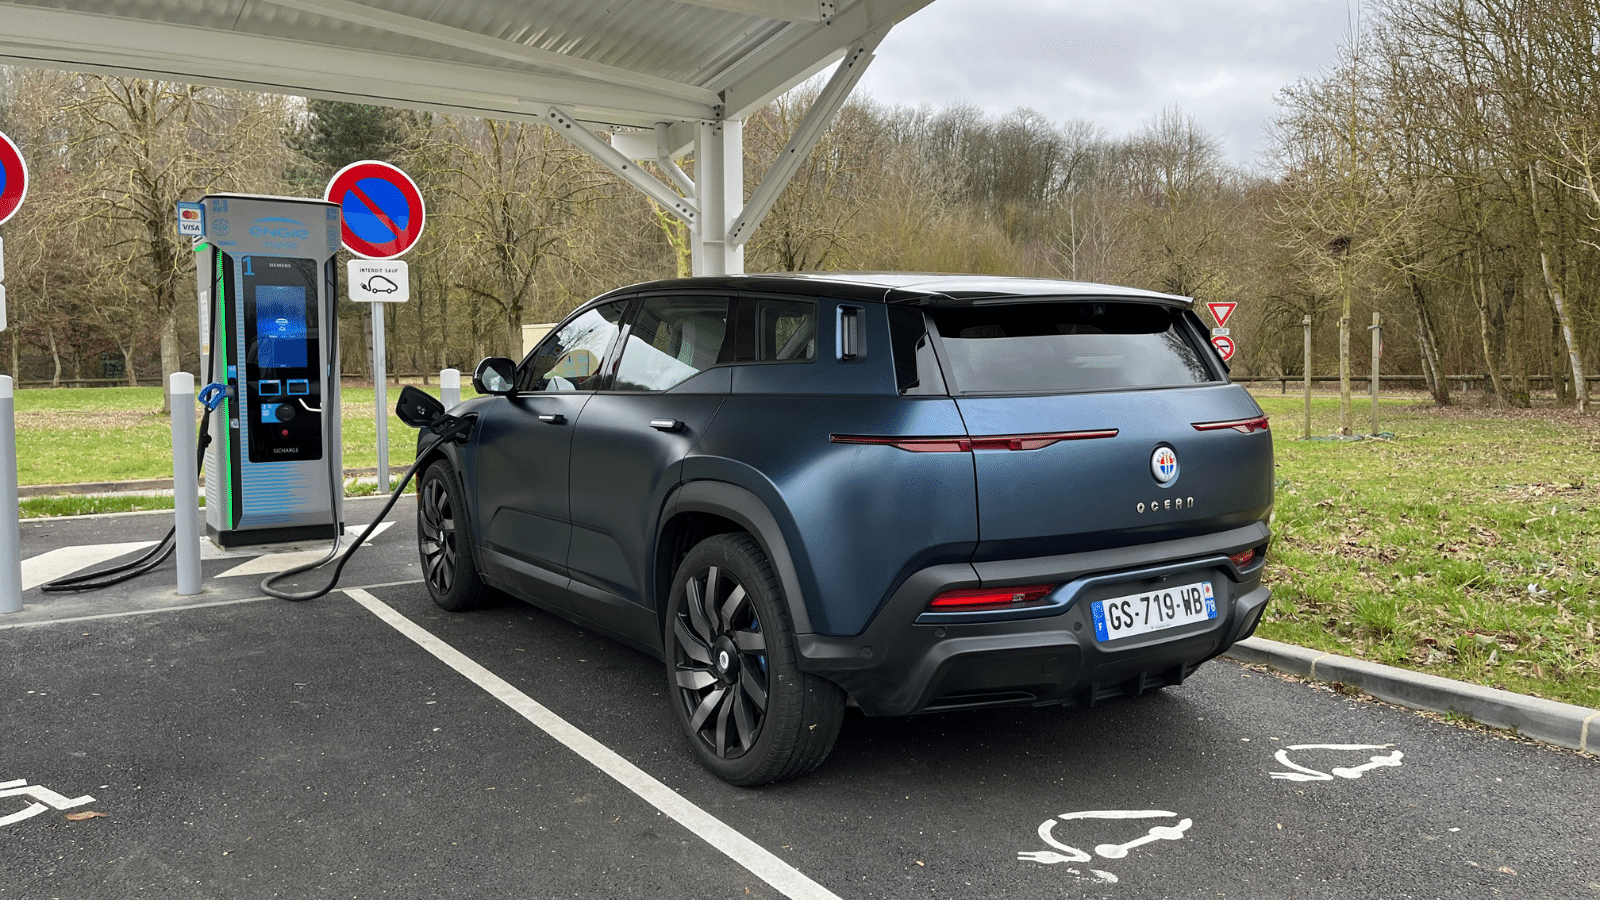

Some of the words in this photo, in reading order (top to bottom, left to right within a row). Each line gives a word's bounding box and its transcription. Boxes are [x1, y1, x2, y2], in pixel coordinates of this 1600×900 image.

[182, 223, 200, 231] VISA
[243, 257, 255, 275] 1
[1136, 497, 1194, 513] OCEAN
[1108, 587, 1204, 630] GS-719-WB
